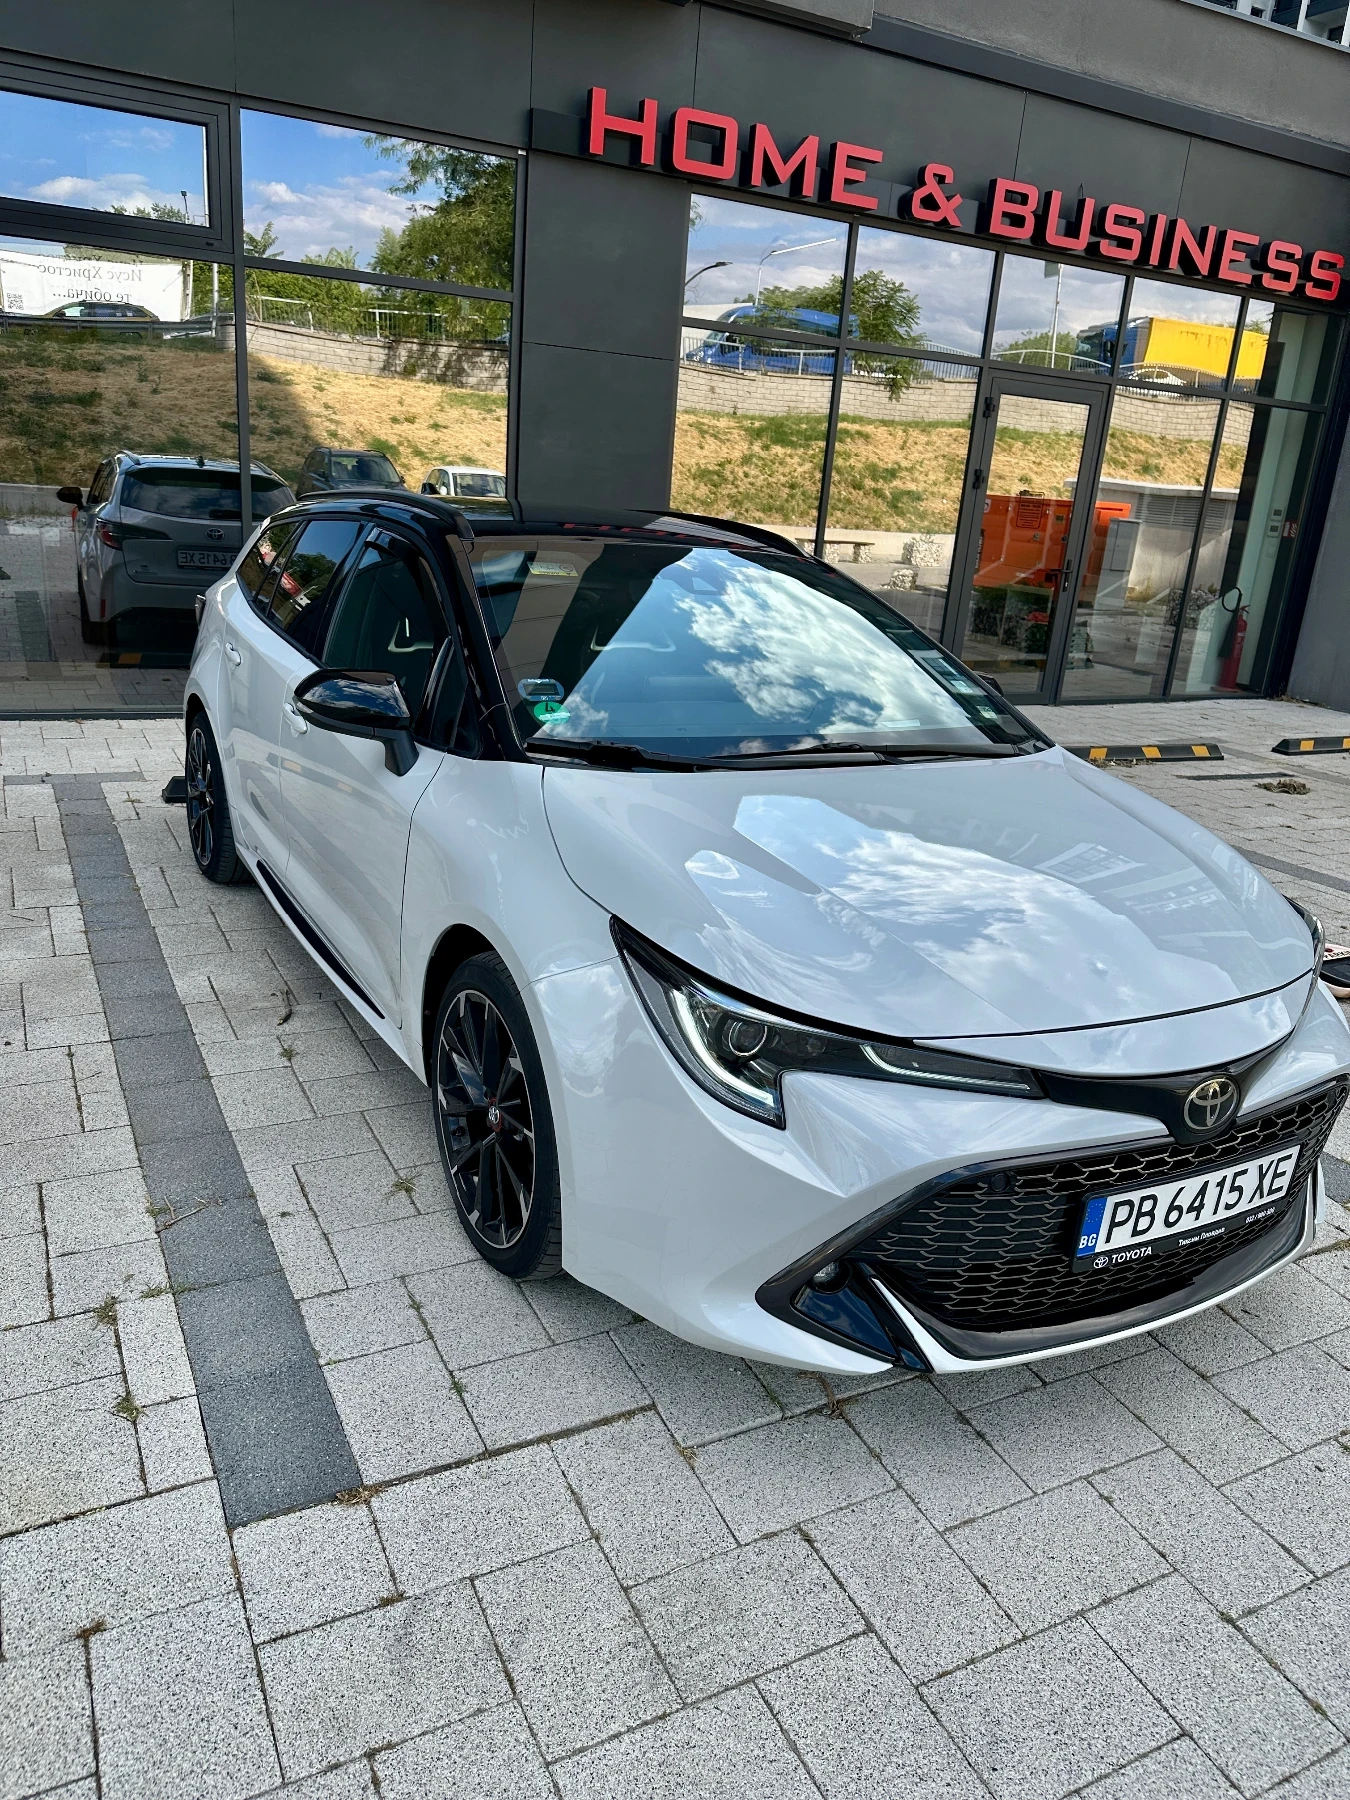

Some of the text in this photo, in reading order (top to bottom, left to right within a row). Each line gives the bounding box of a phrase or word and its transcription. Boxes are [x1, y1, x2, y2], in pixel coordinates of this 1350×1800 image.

[588, 86, 1345, 301] HOME & BUSINESS
[1104, 1153, 1293, 1244] PB 6415 XE
[1079, 1235, 1098, 1249] BG
[1111, 1246, 1152, 1264] TOYOTA
